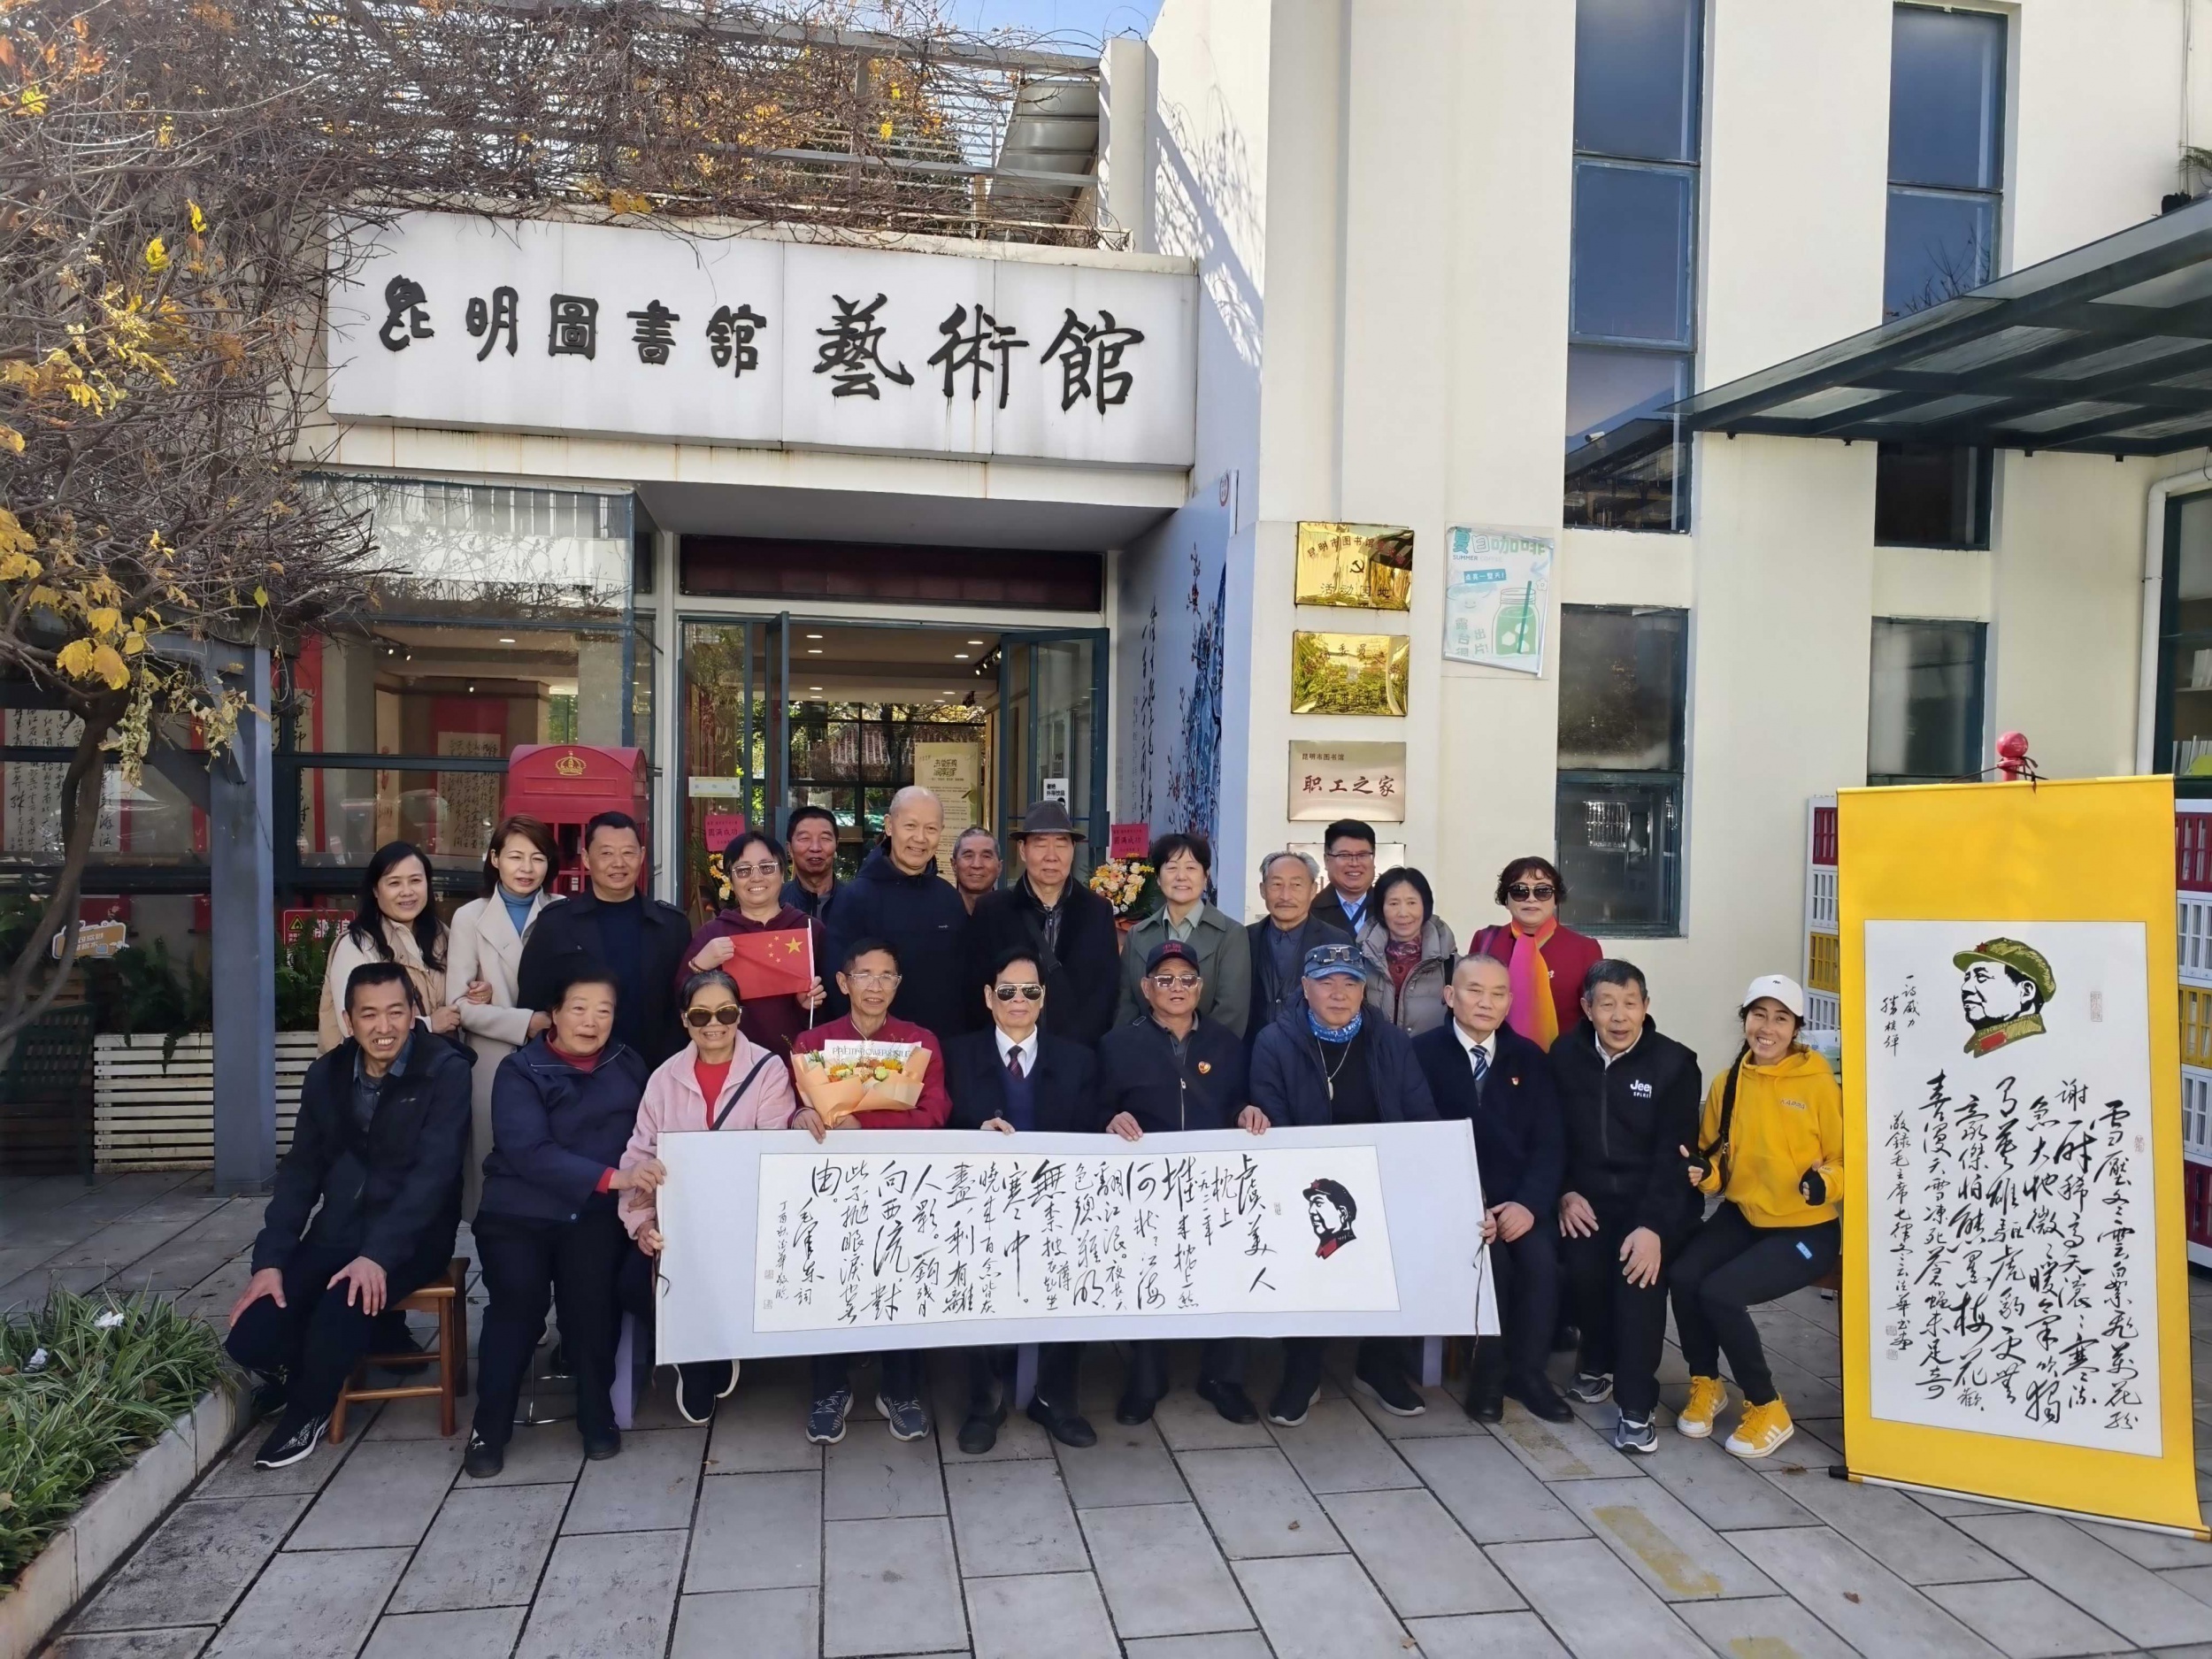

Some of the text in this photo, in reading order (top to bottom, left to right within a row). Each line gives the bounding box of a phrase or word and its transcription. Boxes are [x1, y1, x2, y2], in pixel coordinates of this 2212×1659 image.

[813, 293, 1144, 415] 藝術館
[1320, 582, 1391, 599] 活动园地
[1302, 752, 1345, 761] 昆明市图书馆
[1302, 774, 1395, 797] 职工之家
